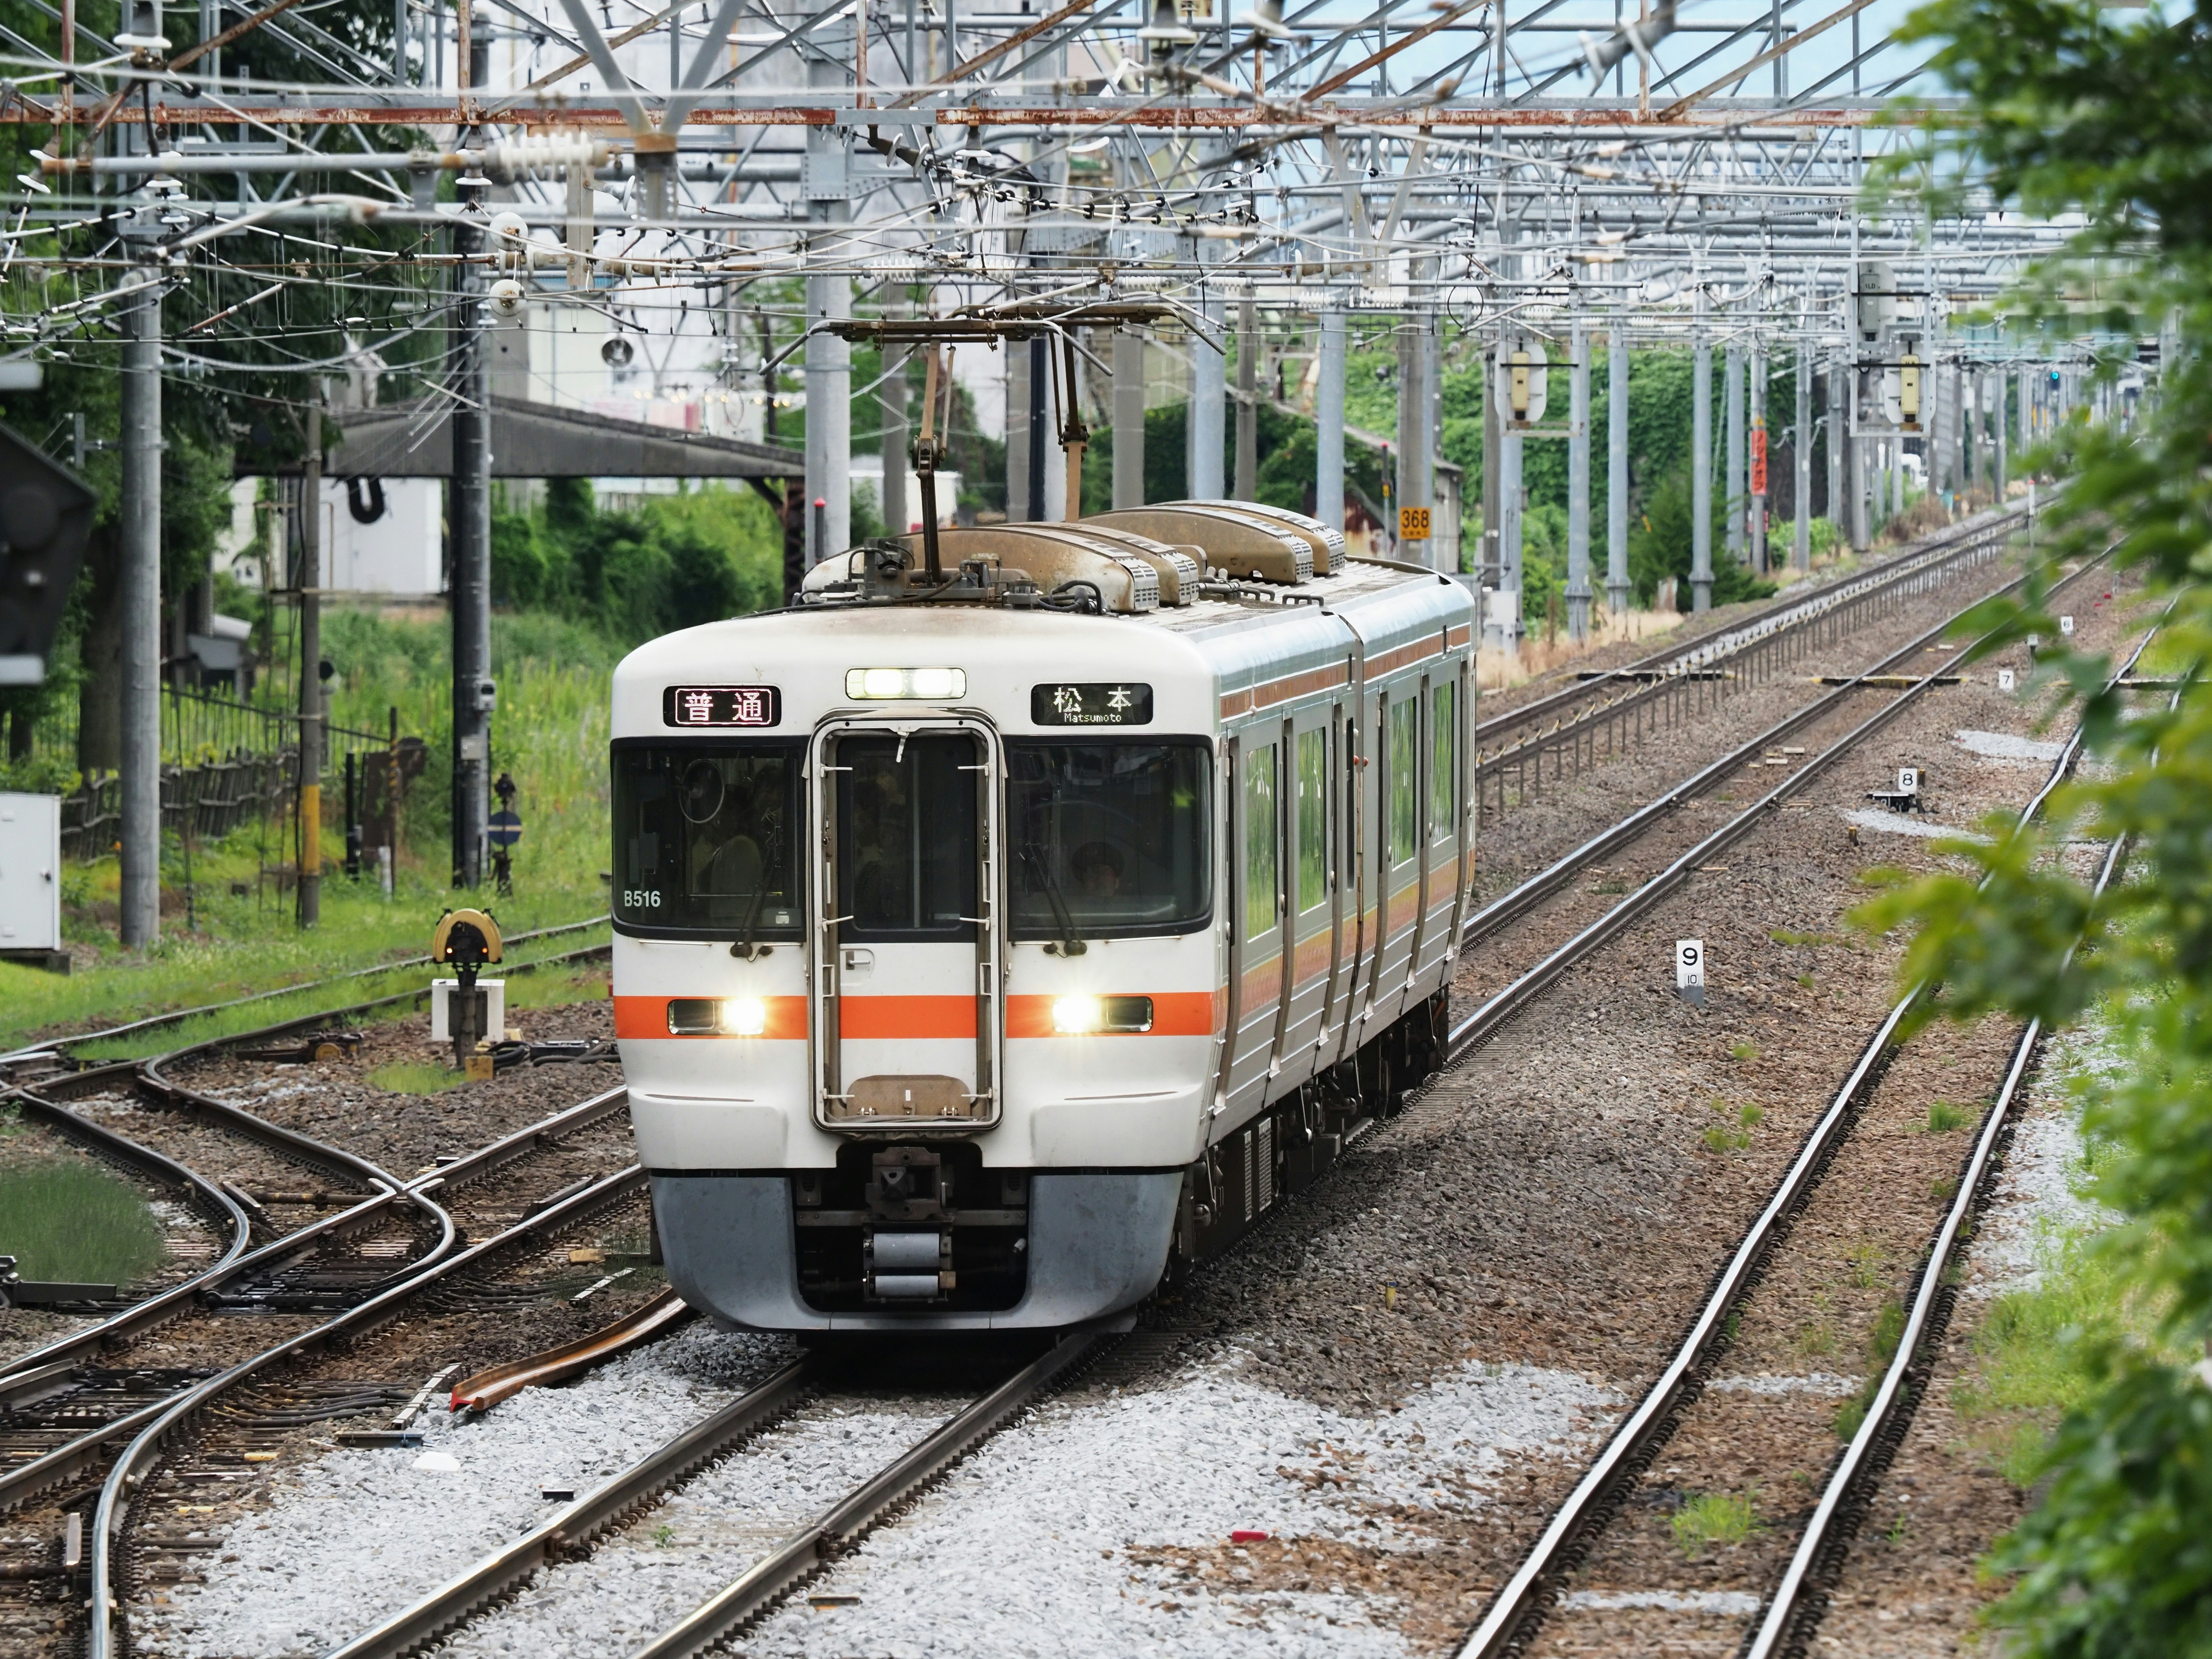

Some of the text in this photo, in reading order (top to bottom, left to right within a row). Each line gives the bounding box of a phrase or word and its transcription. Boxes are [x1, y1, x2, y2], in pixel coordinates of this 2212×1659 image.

[1402, 510, 1429, 528] 368
[2002, 675, 2010, 684] 7
[684, 692, 763, 721] 普通
[1053, 686, 1132, 713] 松本
[1064, 713, 1122, 722] Matsumoto
[1903, 773, 1913, 786] 8
[624, 890, 661, 907] B516
[1682, 947, 1698, 966] 9
[1687, 975, 1697, 984] 10
